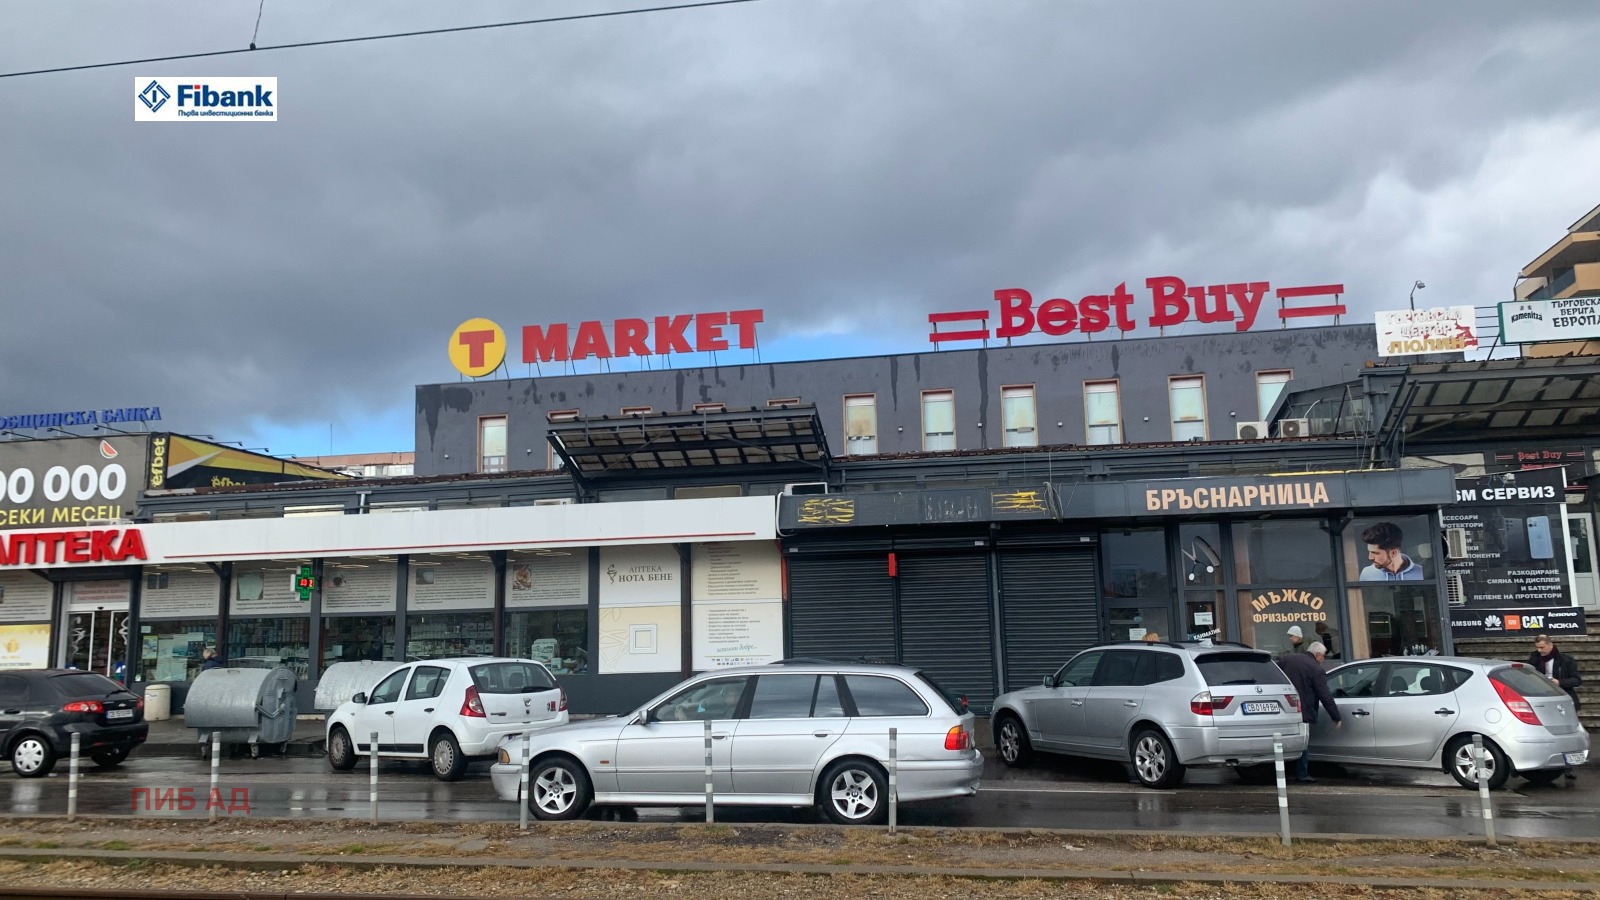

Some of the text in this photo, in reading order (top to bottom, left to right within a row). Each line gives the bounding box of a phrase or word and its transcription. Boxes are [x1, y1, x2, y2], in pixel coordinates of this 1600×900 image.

[994, 276, 1270, 338] Best Buy
[1560, 306, 1595, 316] ВЕРИГА
[459, 309, 764, 368] T MARKET
[1388, 336, 1465, 354] ЛЮЛИН
[102, 406, 162, 424] БАНКА
[151, 437, 166, 487] efbet
[0, 463, 127, 504] 0 000
[1146, 482, 1330, 511] БРЪСНАРНИЦА
[1456, 486, 1556, 502] SM СЕРВИЗ
[52, 505, 121, 523] МЕСЕЦ
[618, 573, 673, 583] НОТА БЕНЕ
[629, 565, 662, 574] АПТЕКА
[1251, 588, 1324, 612] МЪЖКО
[1253, 611, 1327, 623] ФРИЗЬОРСТВО
[1522, 615, 1544, 629] CAT
